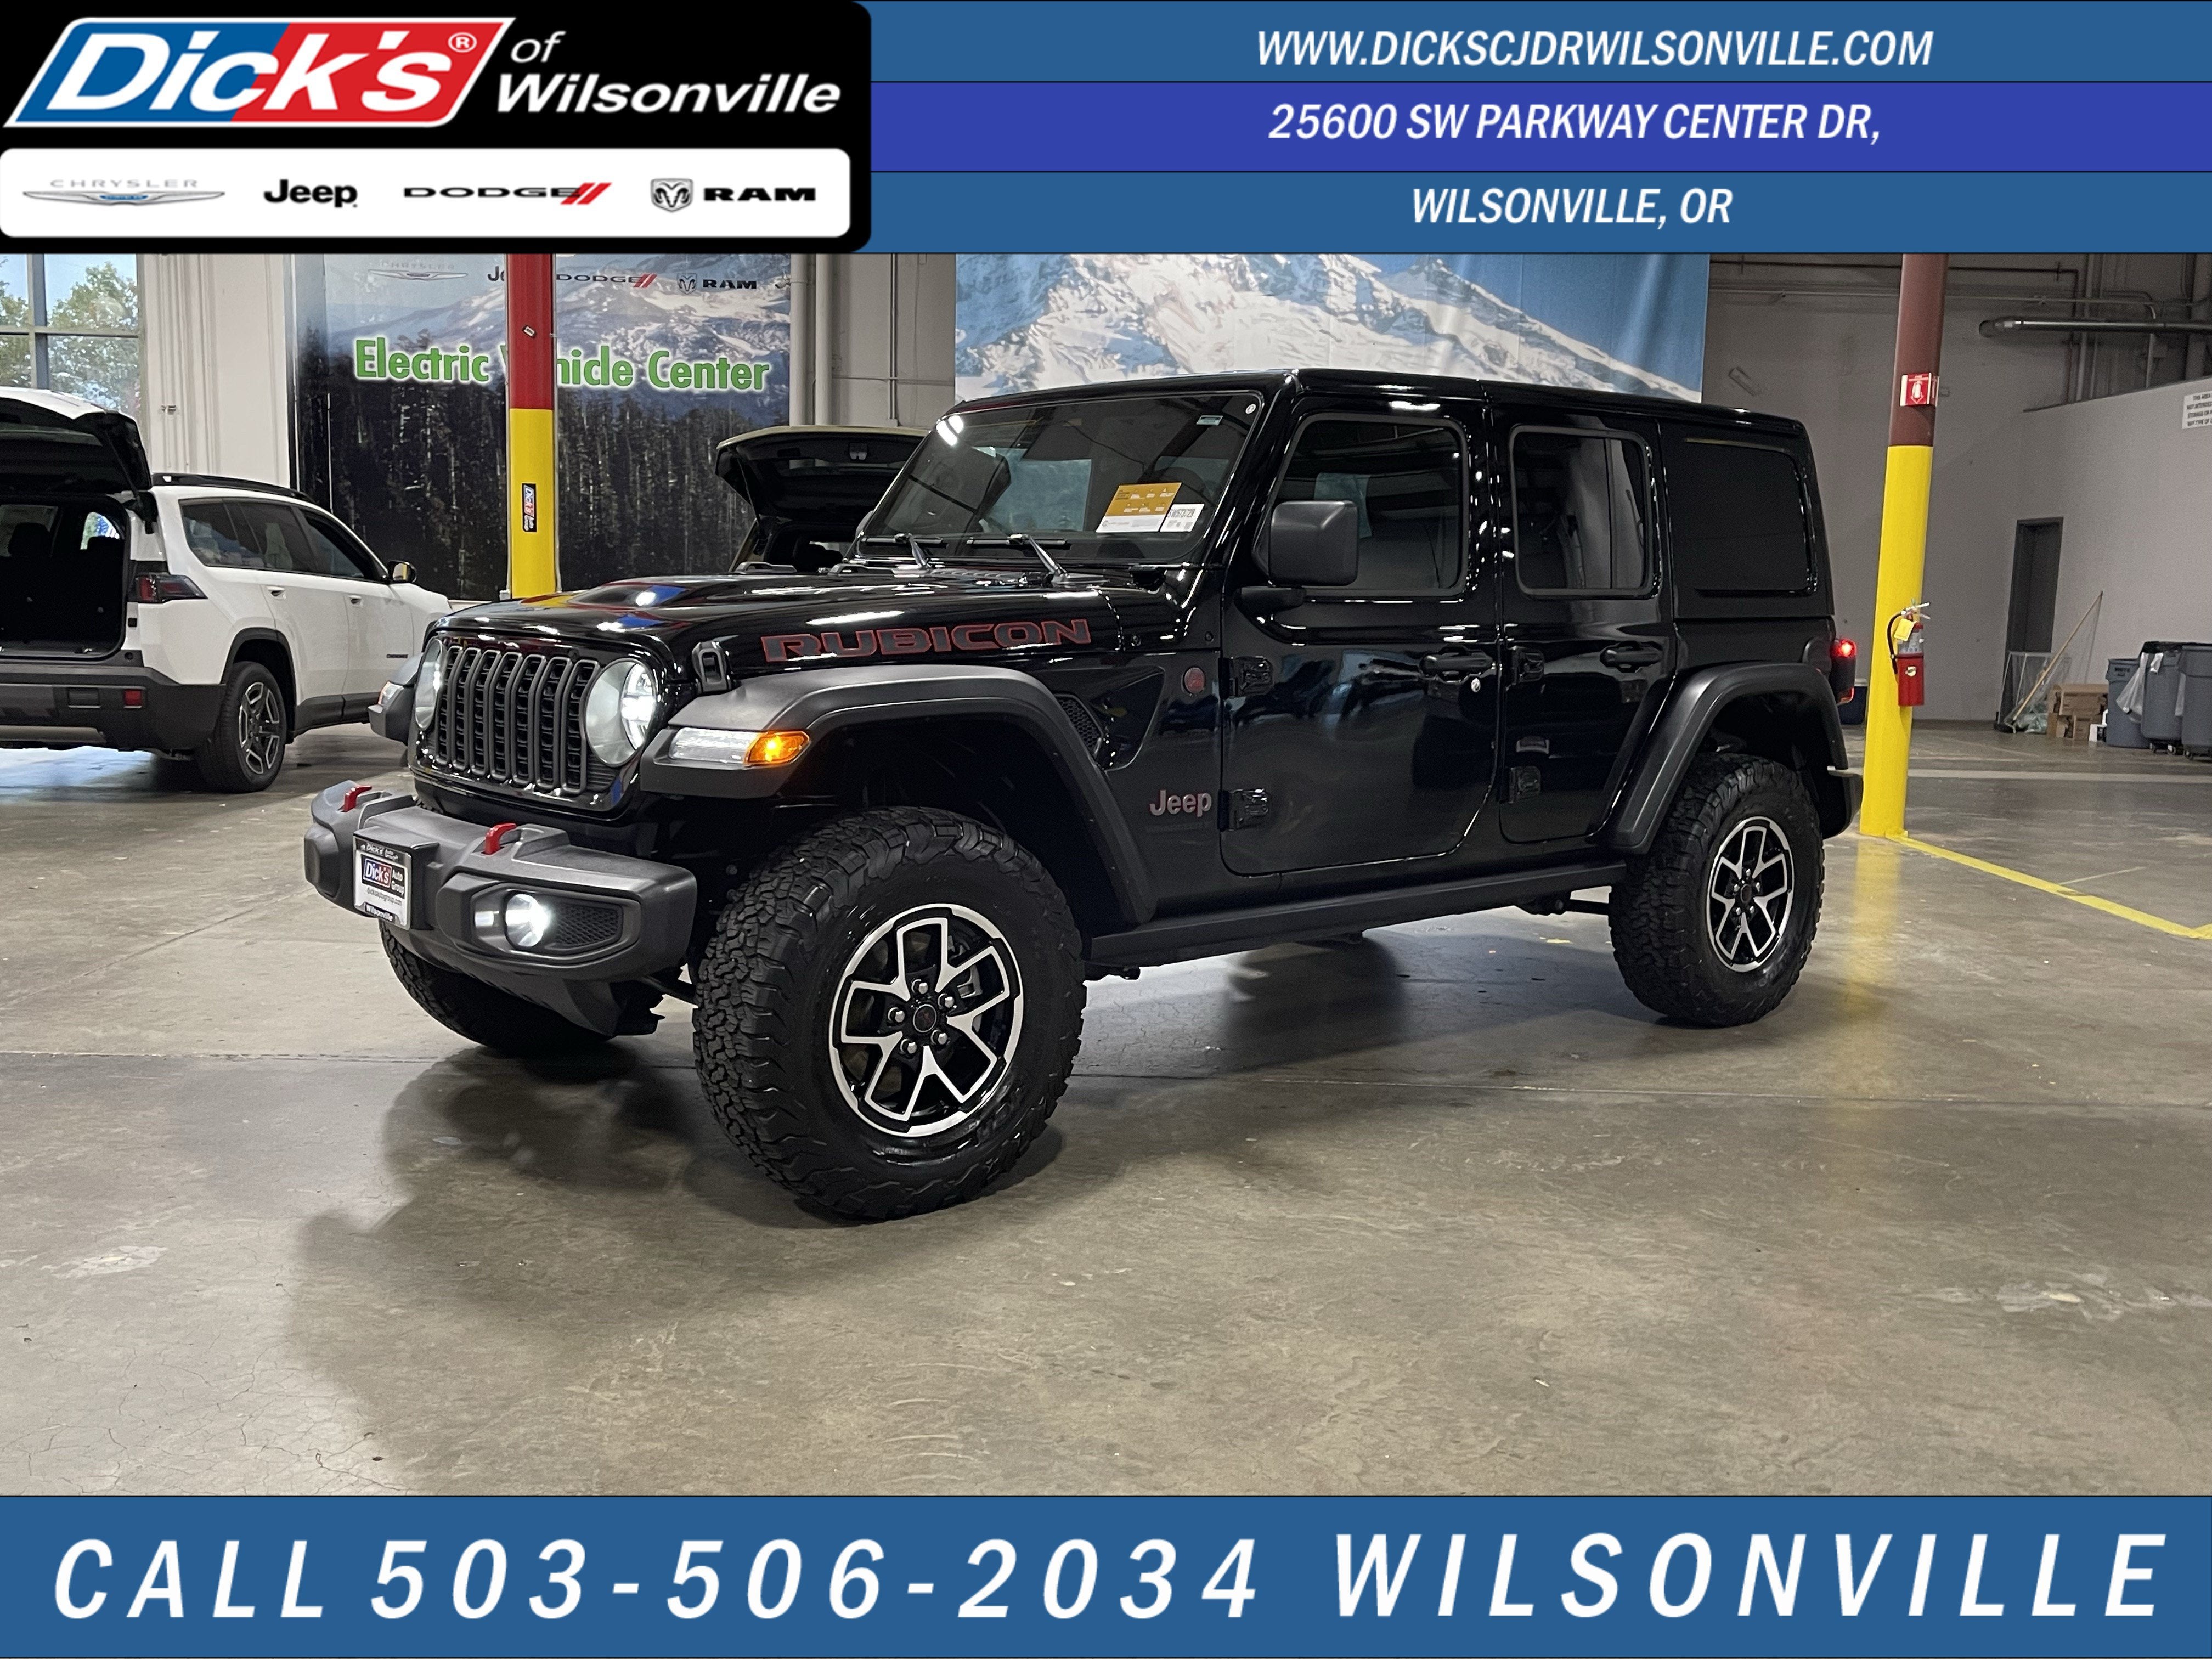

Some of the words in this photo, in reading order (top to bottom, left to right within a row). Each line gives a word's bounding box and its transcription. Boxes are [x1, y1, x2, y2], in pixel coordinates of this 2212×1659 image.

[556, 274, 643, 283] DODGE
[702, 278, 757, 290] RAM
[356, 337, 490, 382] Electric
[648, 350, 770, 390] Center
[760, 618, 1092, 662] RUBICON
[1149, 789, 1212, 818] Jeep
[365, 862, 390, 885] Dick's
[392, 869, 403, 882] Auto
